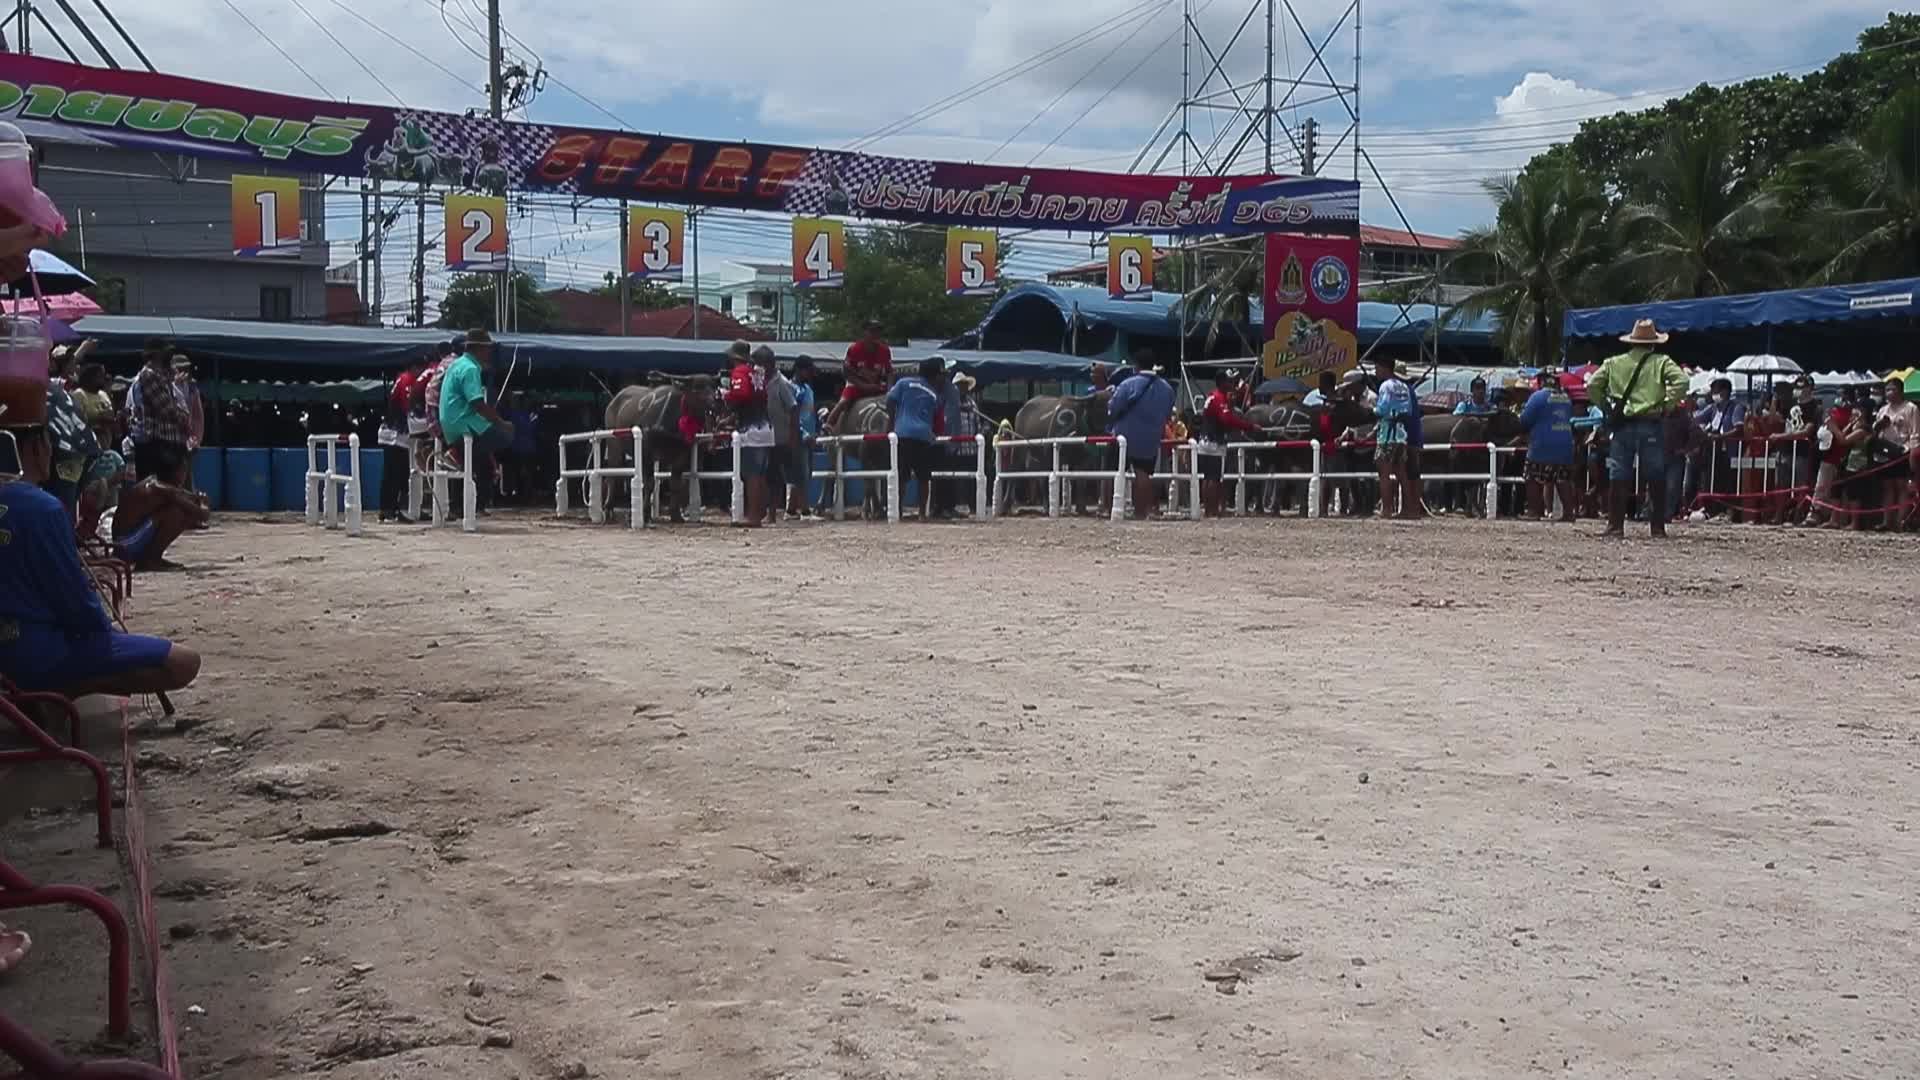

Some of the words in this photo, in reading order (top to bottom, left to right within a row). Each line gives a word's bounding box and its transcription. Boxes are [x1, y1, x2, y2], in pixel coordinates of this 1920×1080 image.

[540, 134, 807, 195] START
[254, 190, 279, 248] 1
[858, 175, 1127, 222] ประเพณีวิ่งควาย
[1136, 181, 1231, 225] ครั้งที่
[462, 208, 495, 264] 2
[642, 220, 672, 272] 3
[804, 232, 833, 281] 4
[960, 242, 988, 288] 5
[1119, 247, 1143, 294] 6
